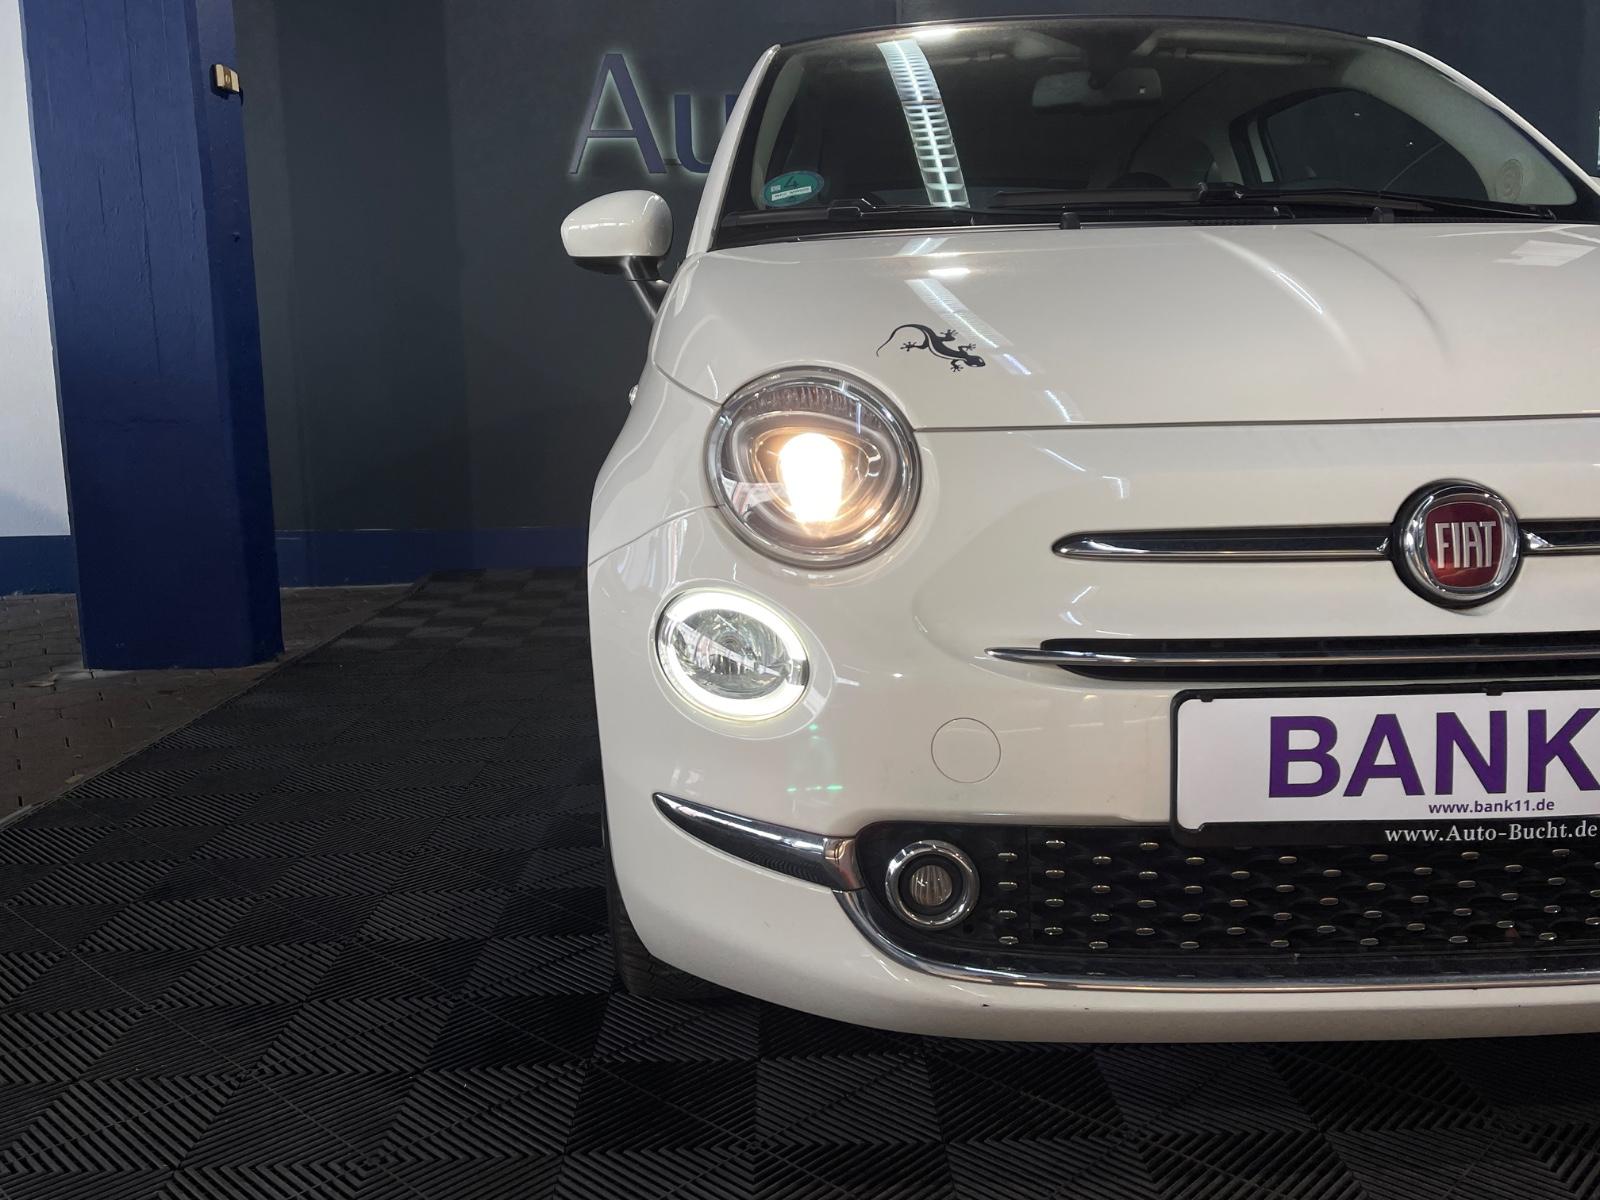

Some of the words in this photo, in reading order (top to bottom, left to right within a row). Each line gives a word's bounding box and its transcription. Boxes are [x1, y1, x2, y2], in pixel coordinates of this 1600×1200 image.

[1435, 521, 1497, 569] FIAT
[1268, 708, 1600, 798] BANK
[1428, 799, 1555, 814] www.bank11.de
[1384, 820, 1598, 842] www.Auto-Bucht.de
